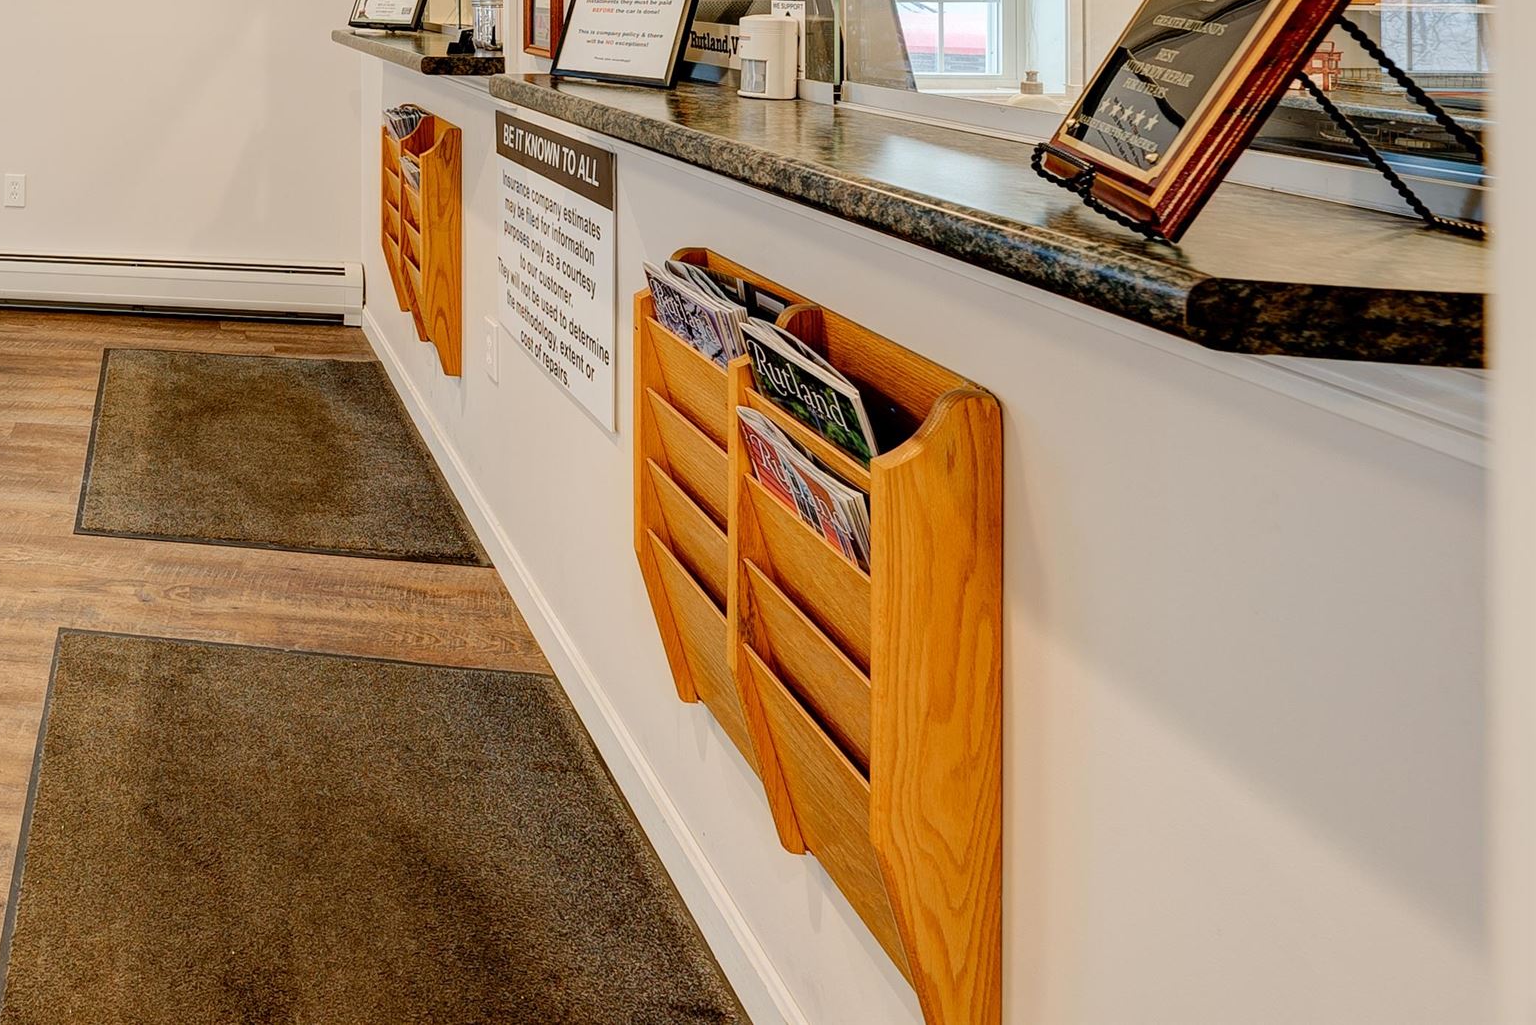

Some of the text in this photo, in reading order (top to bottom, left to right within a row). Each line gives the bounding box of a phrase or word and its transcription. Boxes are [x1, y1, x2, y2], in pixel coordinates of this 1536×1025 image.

[1152, 14, 1188, 31] GREATER
[1155, 48, 1180, 63] BEST
[1161, 69, 1195, 87] REPAIR
[503, 123, 600, 187] BE IT KNOWN TO ALL
[503, 169, 601, 241] Insurance company estimates
[504, 198, 595, 266] may be filed for information
[504, 220, 596, 300] purposes only as a courtesy
[520, 252, 573, 308] to our customer.
[498, 256, 609, 366] They will not be used to determine
[507, 288, 594, 382] the methodology, extent or
[650, 278, 716, 343] Rutland
[521, 330, 570, 388] cost of repairs.
[746, 339, 850, 432] Rutland
